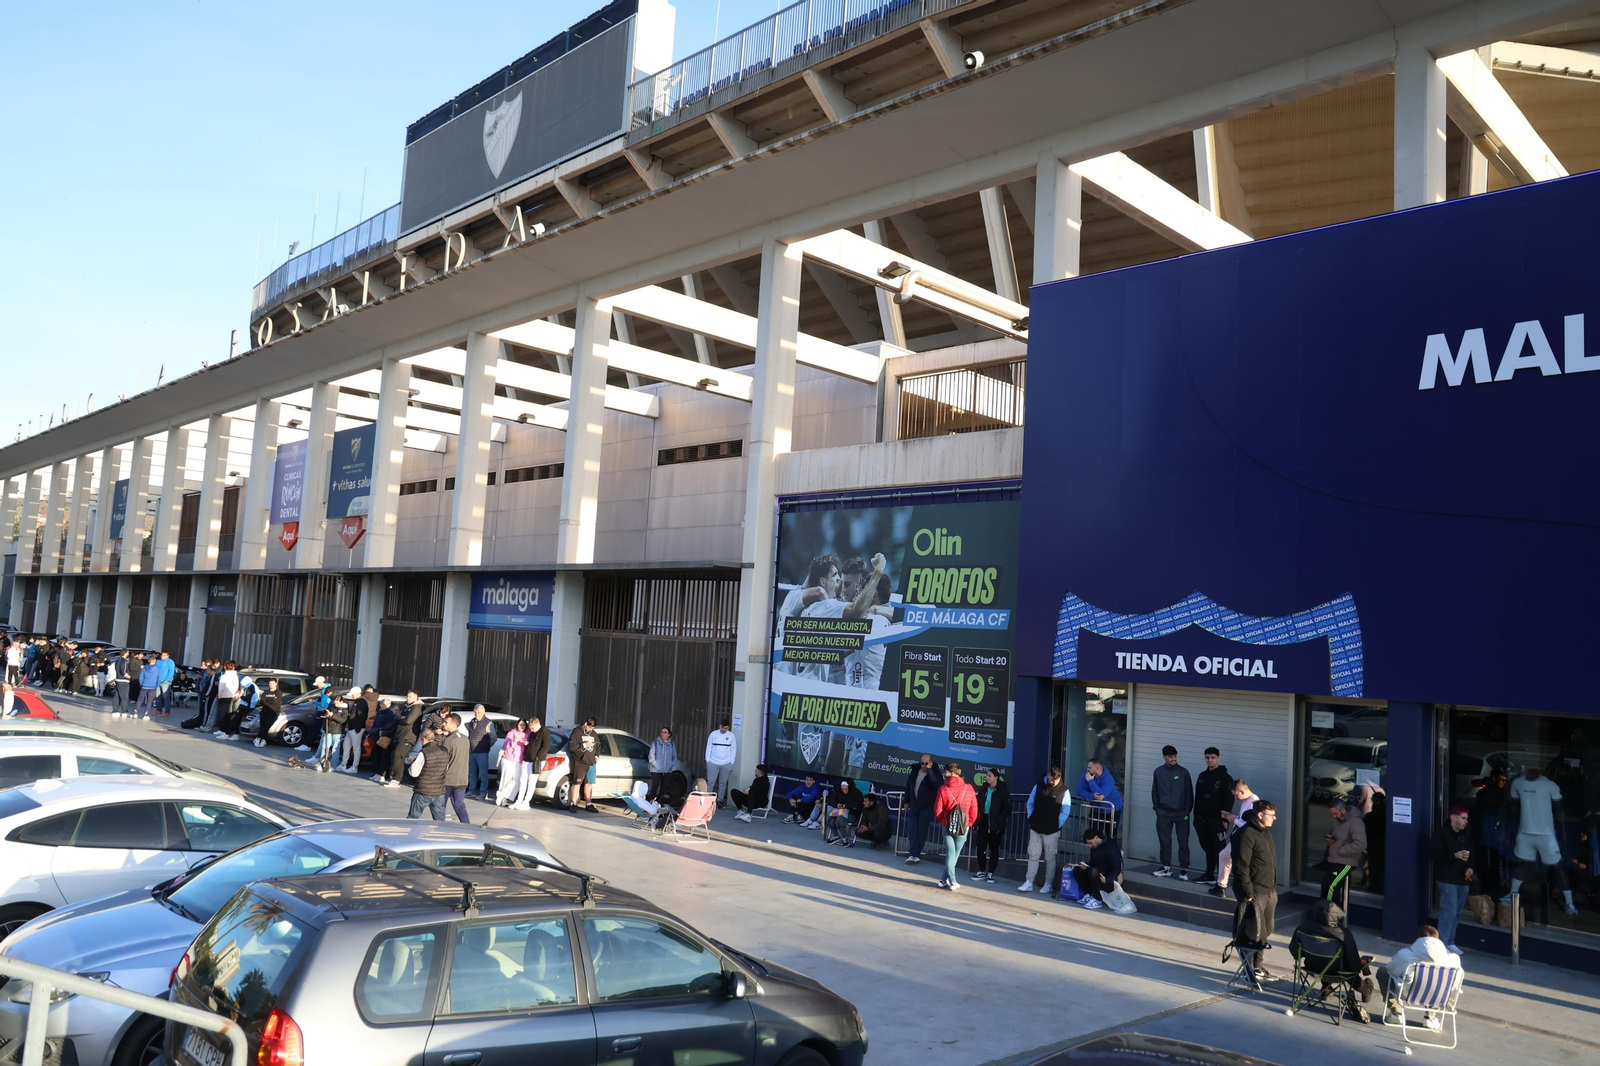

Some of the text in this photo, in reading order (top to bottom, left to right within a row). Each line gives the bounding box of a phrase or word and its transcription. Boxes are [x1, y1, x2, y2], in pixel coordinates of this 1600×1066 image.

[1418, 313, 1600, 390] MAL
[338, 478, 356, 491] vithas
[280, 506, 298, 518] DENTAL
[342, 524, 358, 538] Aquí
[913, 528, 962, 556] Olin
[906, 567, 998, 604] FOROFOS
[1171, 601, 1187, 609] OFICIAL
[906, 609, 1007, 626] DEL MÁLAGA CF
[1070, 612, 1086, 620] MALAGA
[1174, 611, 1190, 620] OFICIAL
[1191, 605, 1210, 614] MALAGA
[1222, 614, 1238, 622] TIENDA
[786, 620, 871, 633] POR SER MALAGUISTA,
[1131, 619, 1149, 627] MALAGA
[1225, 618, 1260, 632] TIENDA OFICIAL
[1295, 619, 1313, 628] TIENDA
[1314, 613, 1333, 622] OFICIAL
[1133, 629, 1151, 638] MALAGA
[1246, 629, 1264, 638] OFICIAL
[1264, 622, 1286, 632] MALAGA
[1298, 624, 1337, 639] TIENDA OFICIAL
[786, 635, 860, 647] TE DAMOS NUESTRA
[1268, 633, 1289, 643] MALAGA
[784, 650, 840, 662] MEJOR OFERTA
[904, 651, 942, 662] Fibra Start
[955, 654, 1007, 665] Todo Start 20
[1116, 652, 1278, 678] TIENDA OFICIAL
[901, 669, 939, 699] 15 €
[954, 673, 994, 704] 19 €
[1335, 681, 1354, 691] OFICIAL
[800, 697, 824, 722] POR
[824, 698, 881, 729] USTEDES!
[900, 709, 926, 719] 300Mb
[955, 715, 983, 726] 300Mb
[954, 730, 976, 741] 20GB
